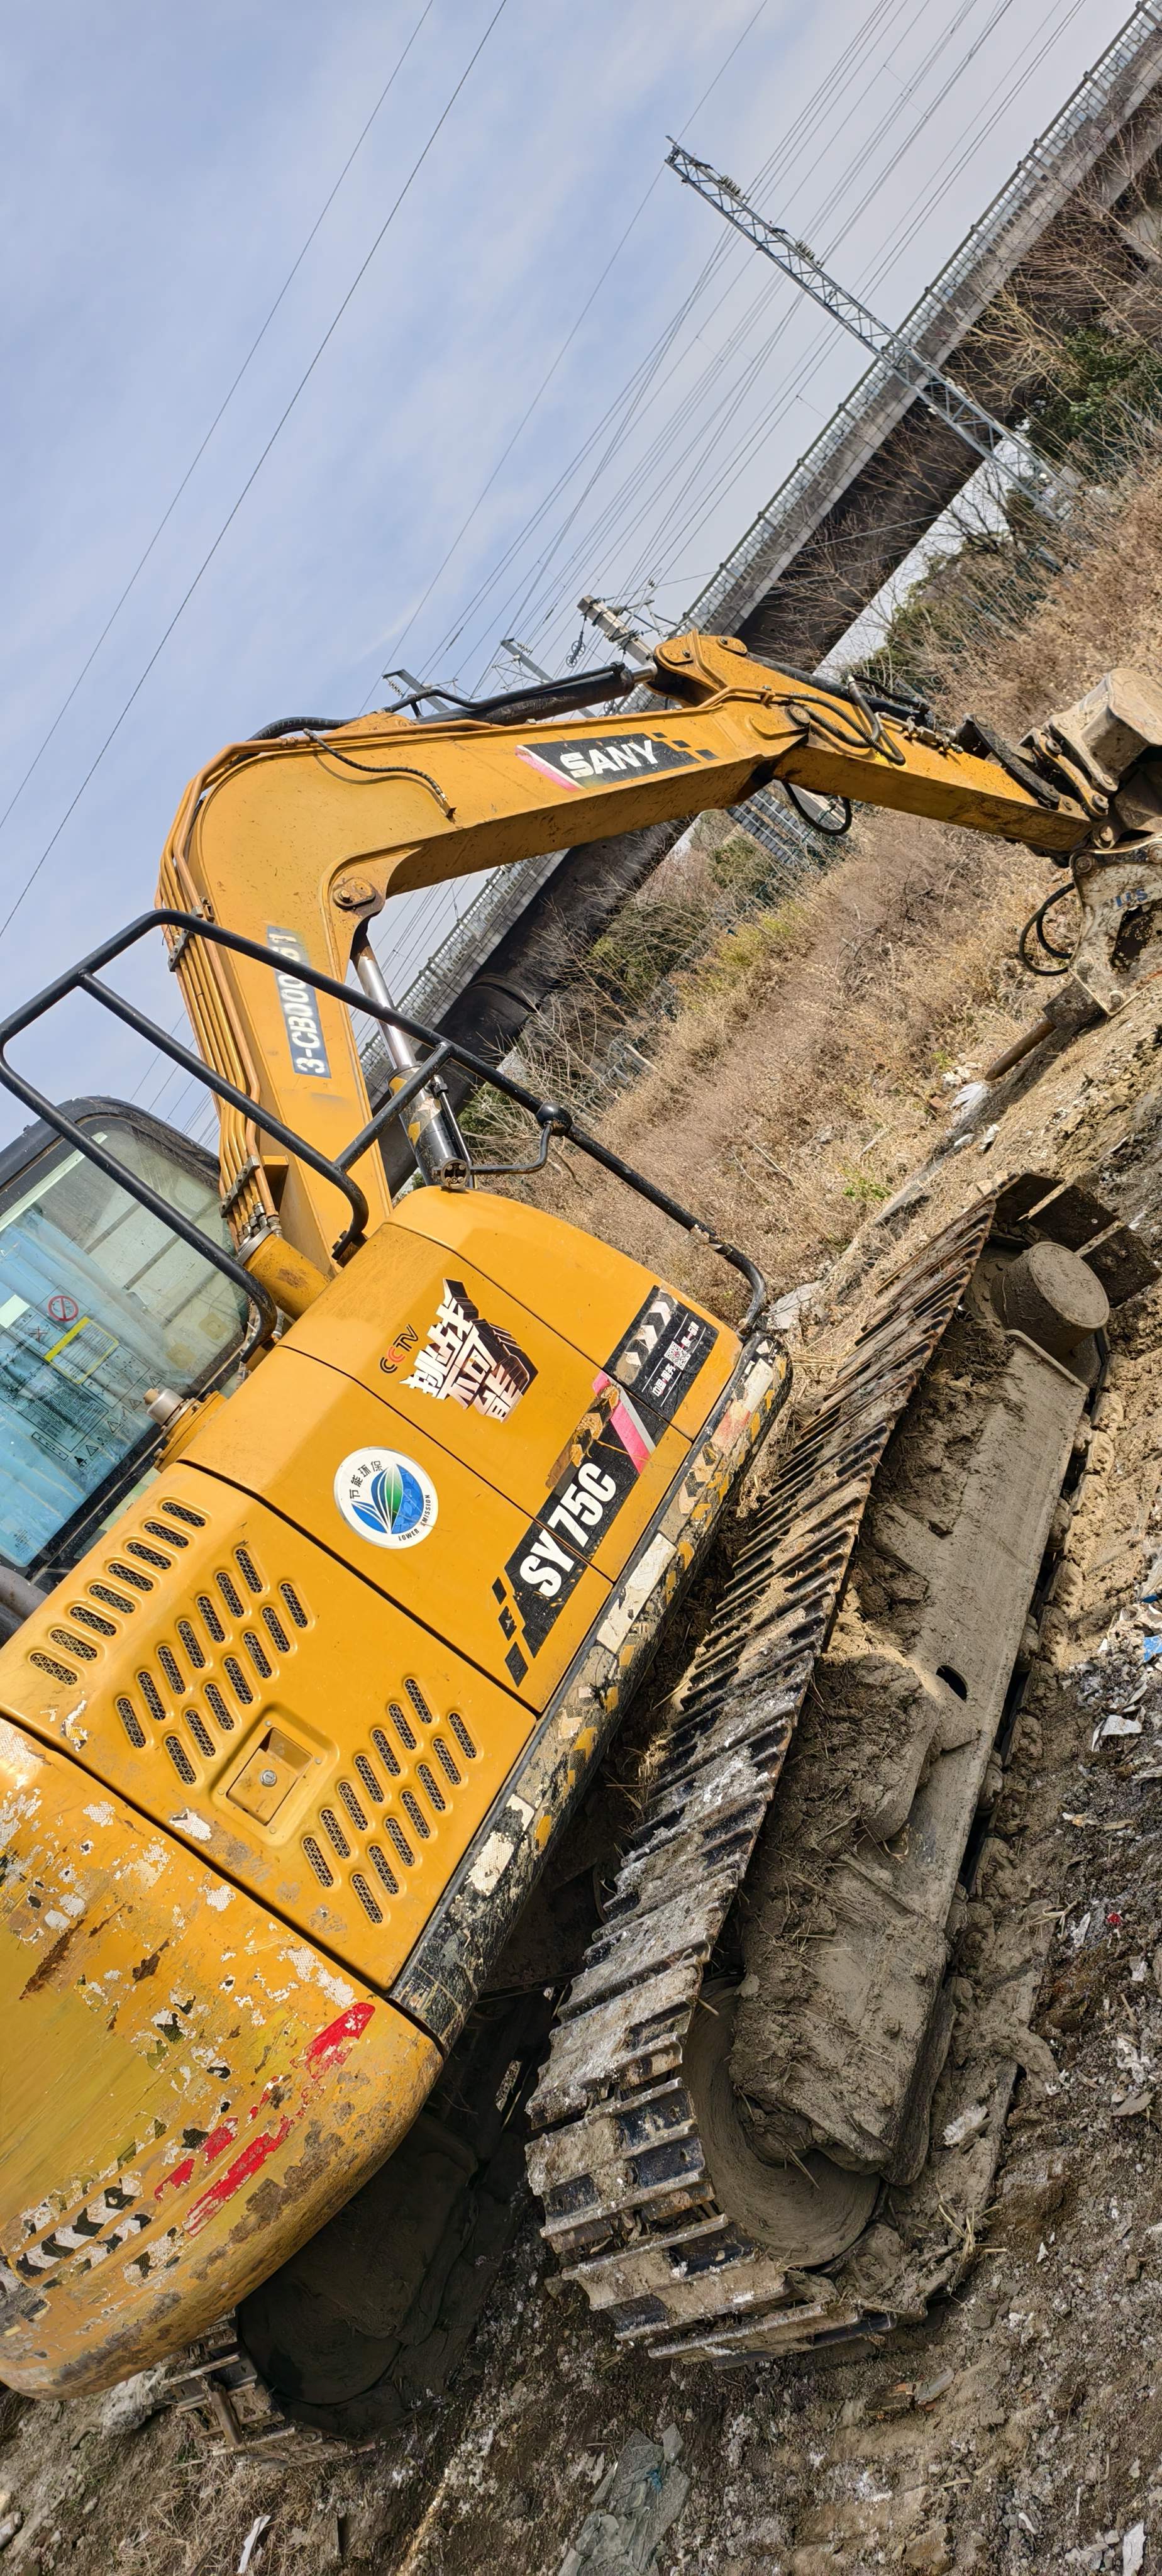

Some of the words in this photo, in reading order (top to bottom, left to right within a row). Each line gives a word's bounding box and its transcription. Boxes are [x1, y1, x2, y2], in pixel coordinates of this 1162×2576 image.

[560, 740, 660, 778] SANY
[268, 933, 325, 1074] 3-CB00061
[380, 1324, 419, 1374] CCTV
[349, 1460, 383, 1499] 节能环保
[398, 1528, 419, 1541] LOWER
[421, 1494, 431, 1526] EMISSION
